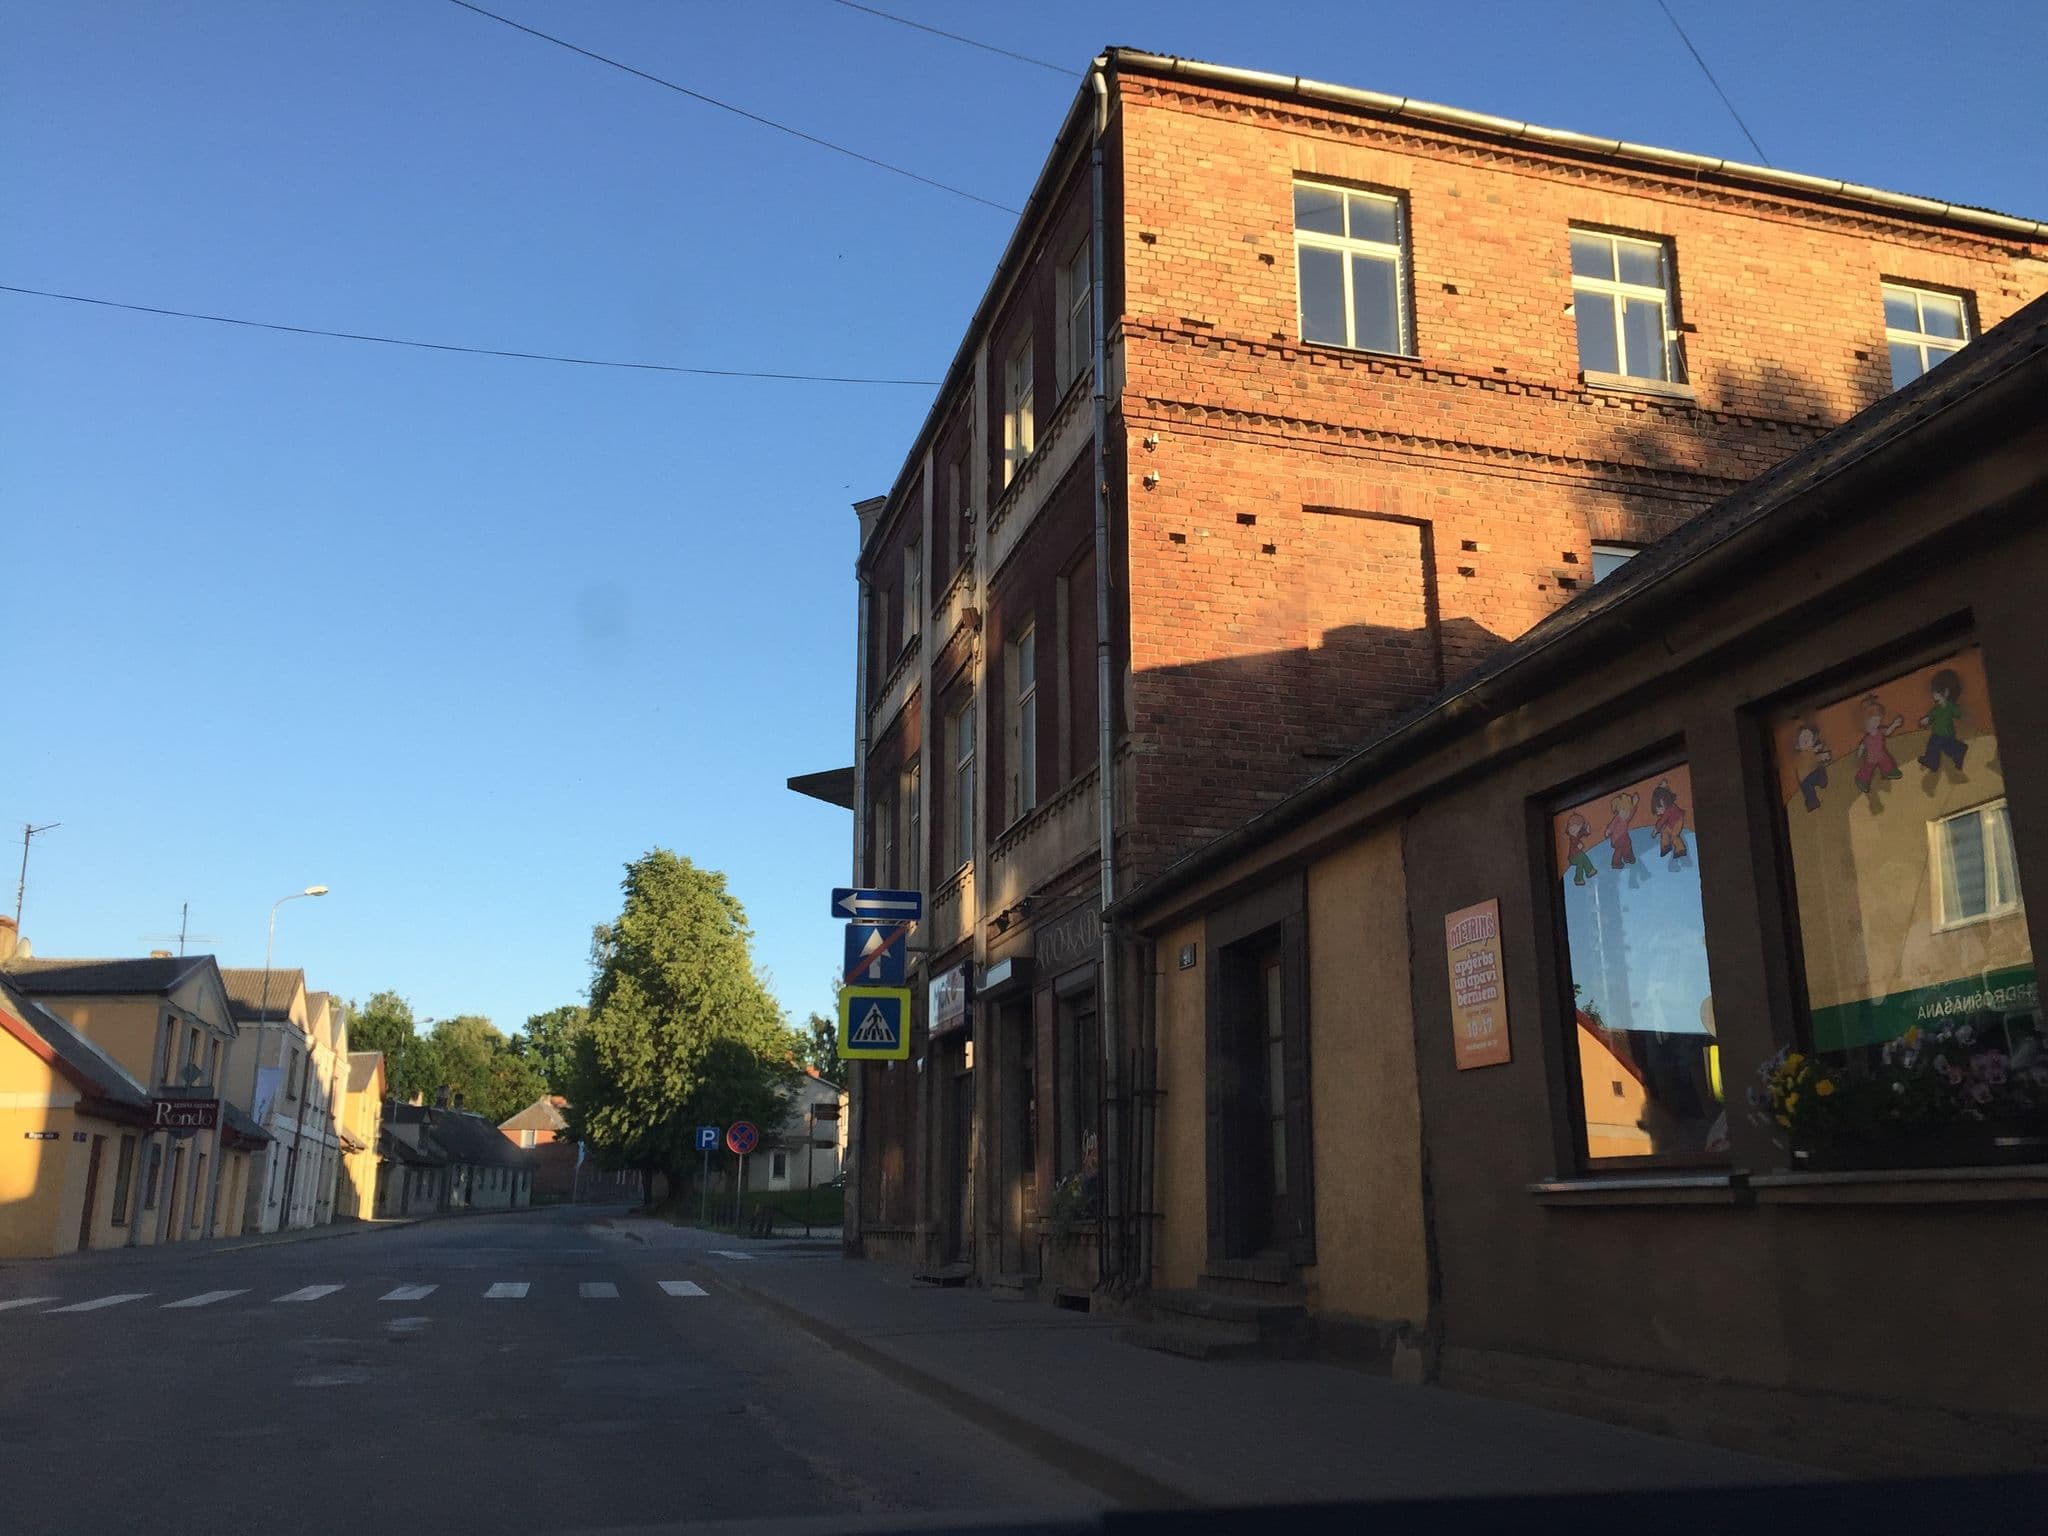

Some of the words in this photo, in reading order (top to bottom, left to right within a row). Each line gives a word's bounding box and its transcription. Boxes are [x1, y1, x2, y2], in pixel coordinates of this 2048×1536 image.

[1454, 976, 1467, 989] un
[1467, 966, 1497, 989] apavi
[1456, 985, 1497, 1007] bērniem
[154, 1102, 213, 1125] Rondo
[702, 1130, 715, 1147] P
